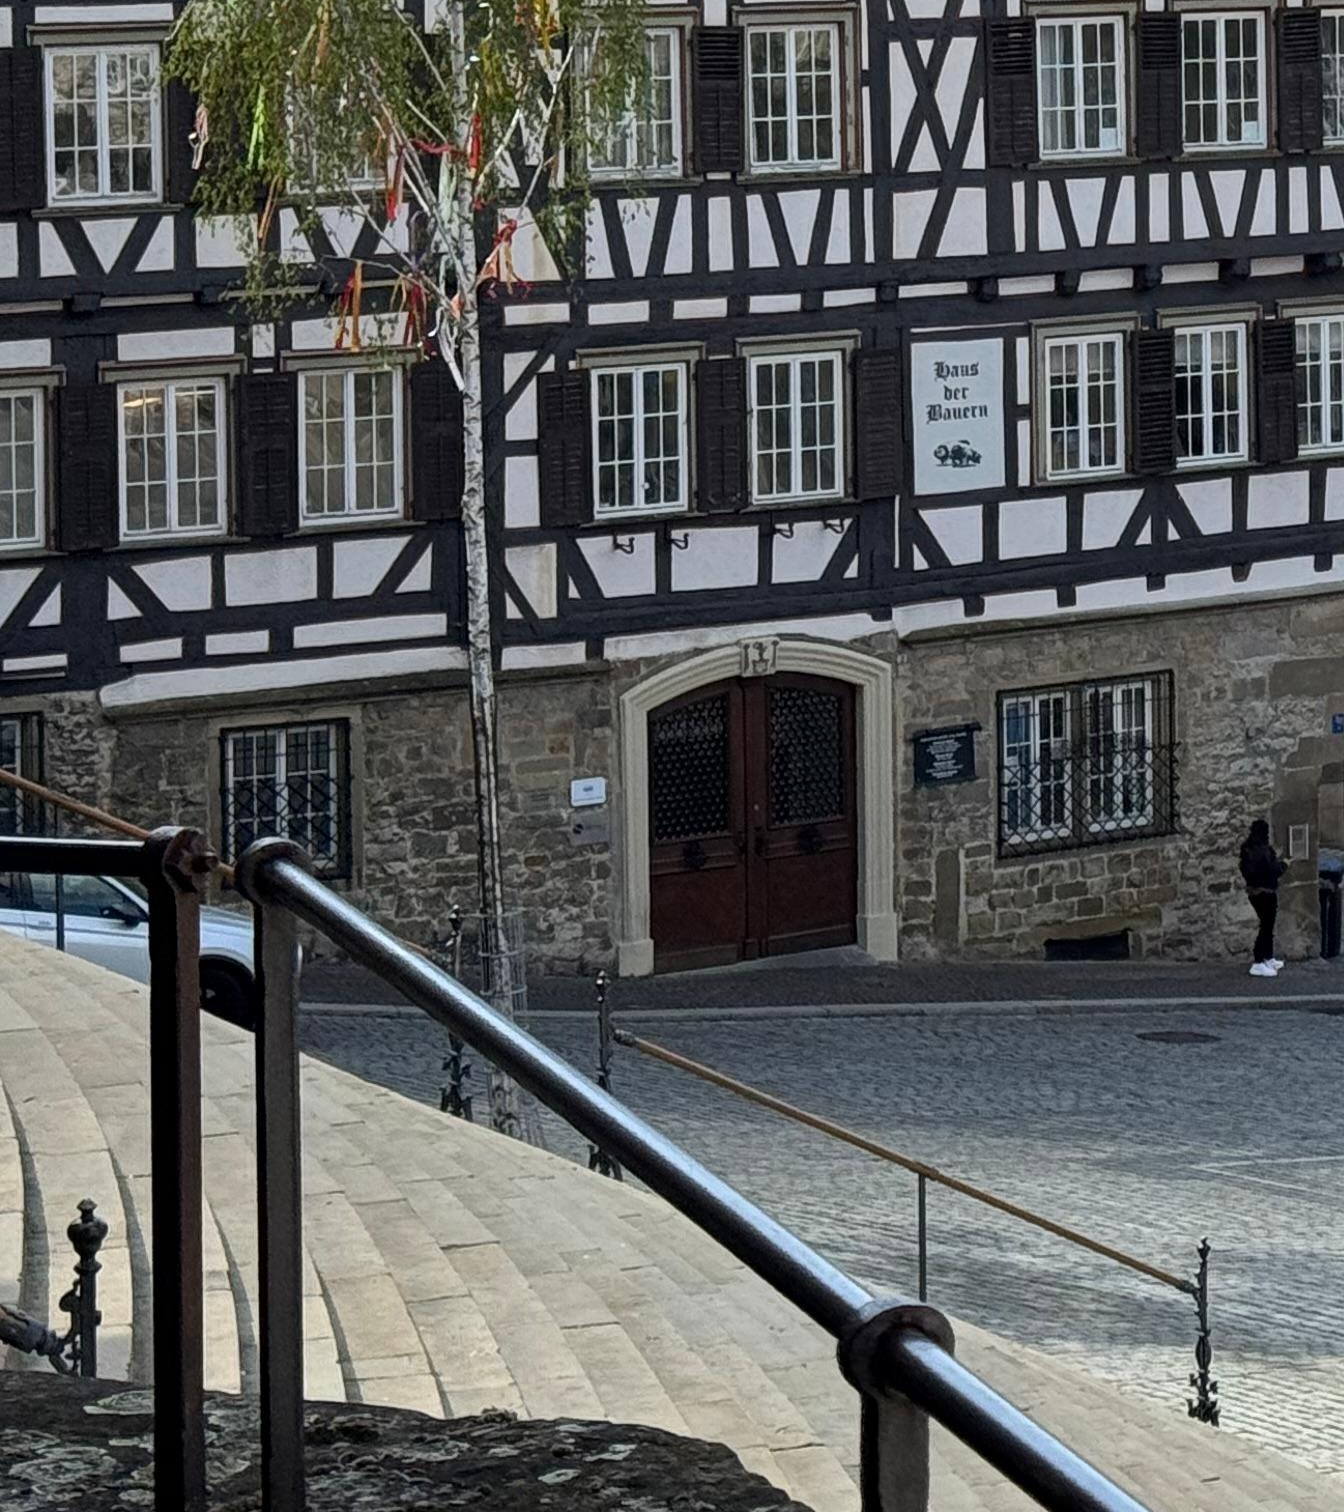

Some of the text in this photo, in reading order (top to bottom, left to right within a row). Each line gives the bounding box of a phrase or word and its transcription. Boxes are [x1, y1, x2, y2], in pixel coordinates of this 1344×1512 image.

[933, 361, 980, 381] Haus
[943, 385, 969, 400] der
[926, 403, 989, 424] Bauern
